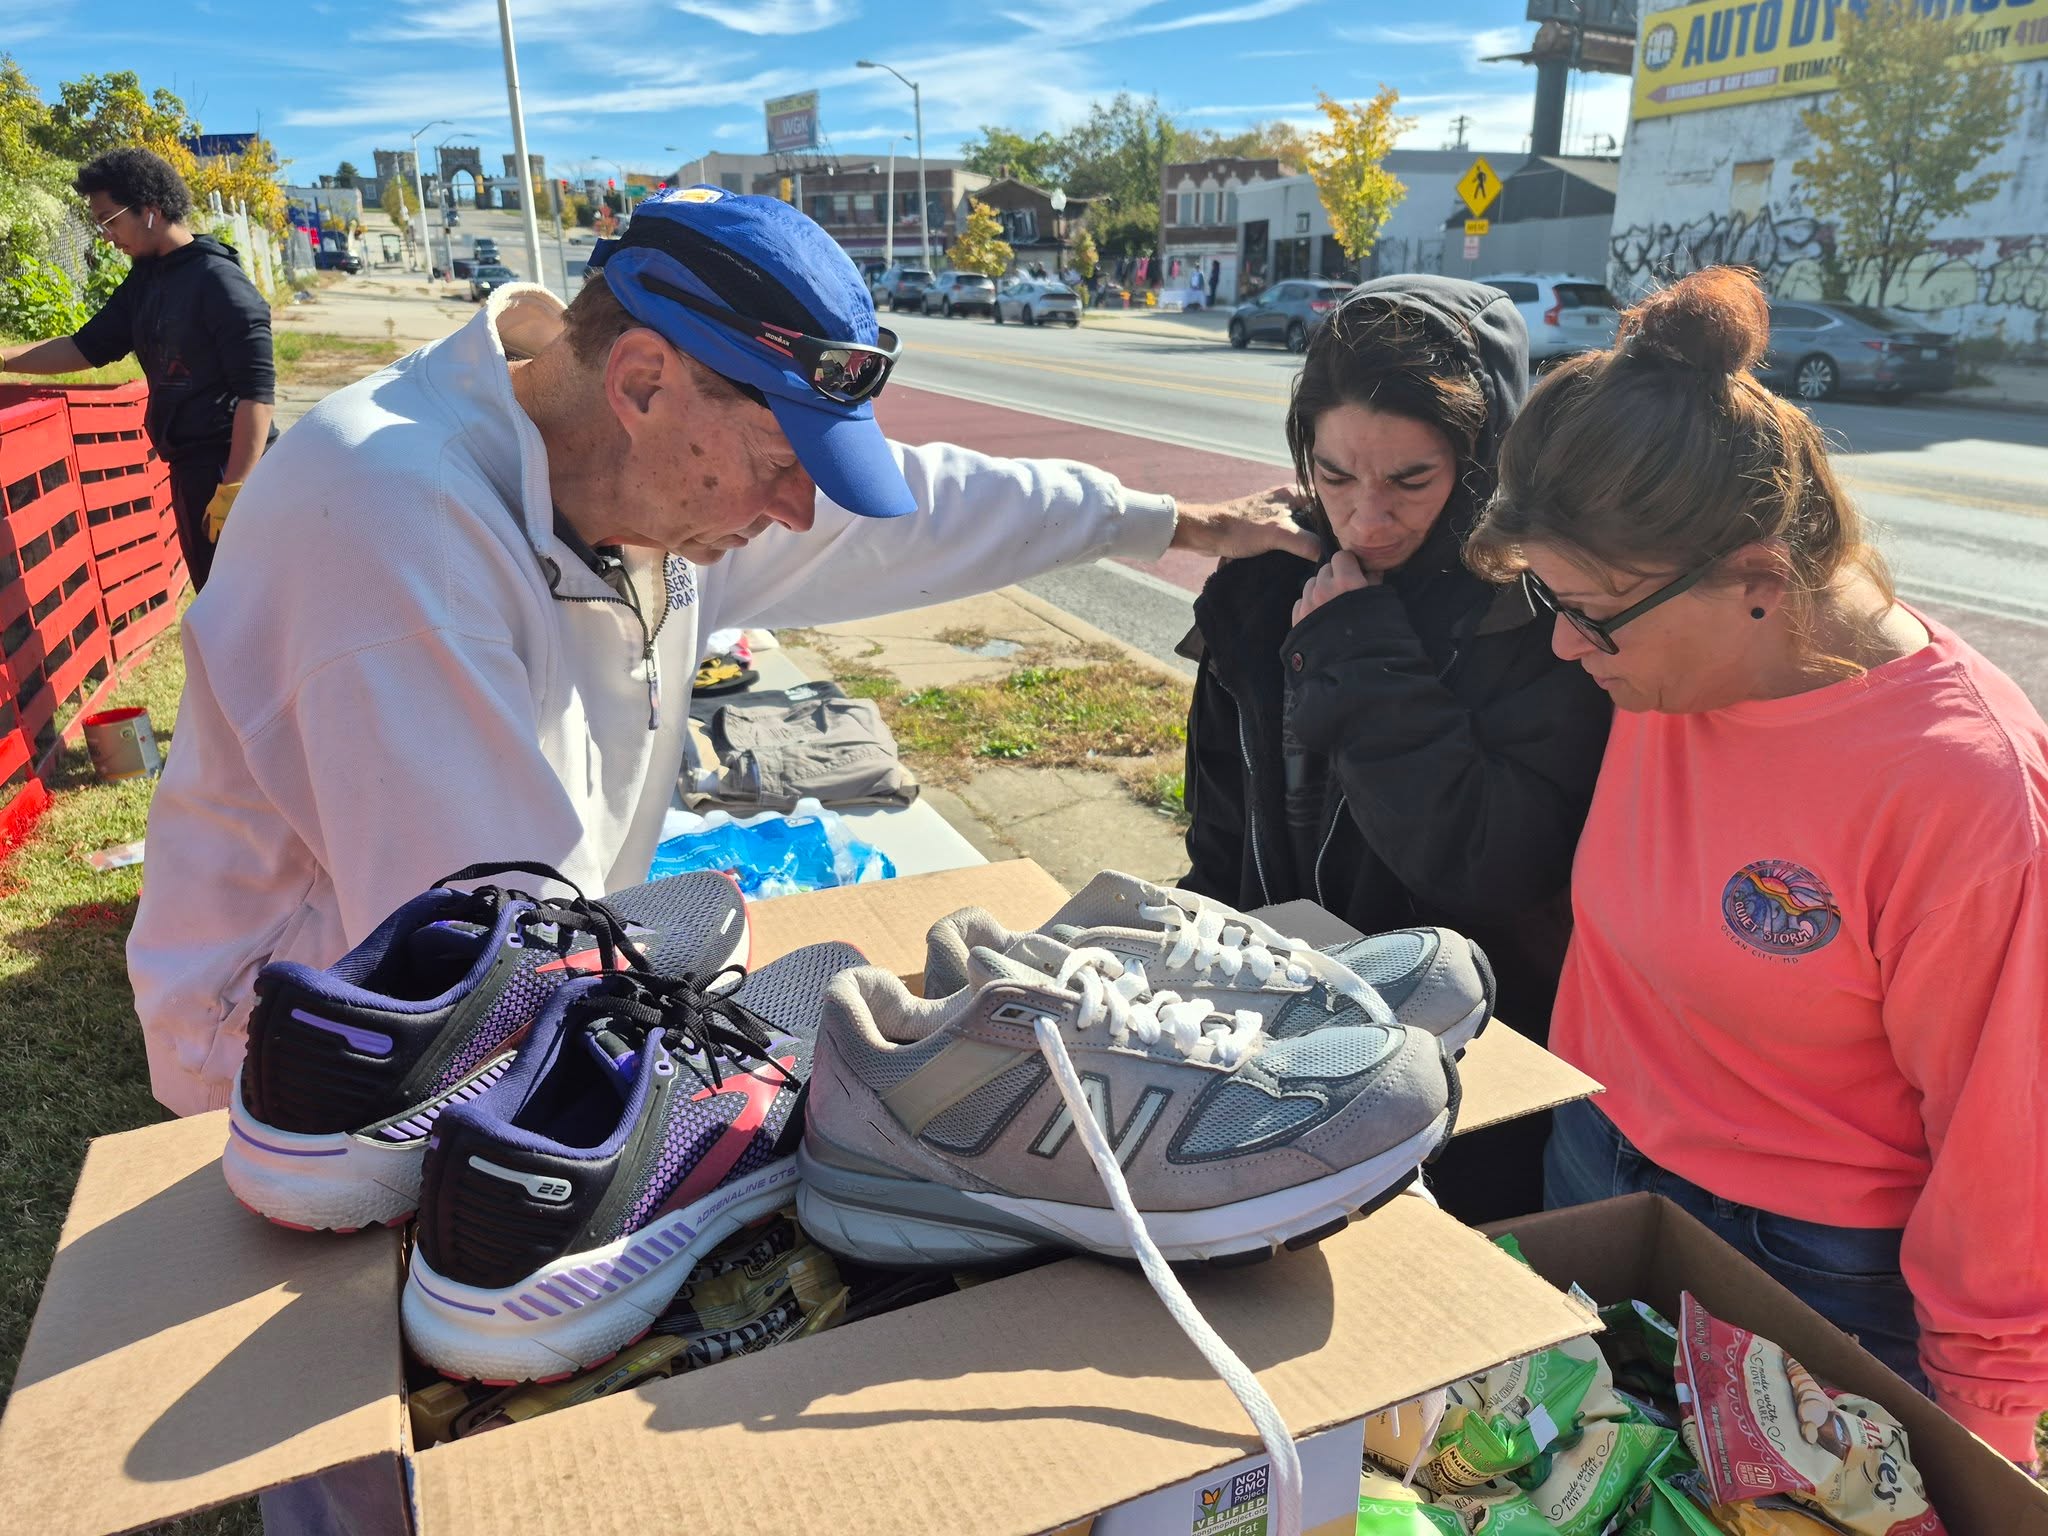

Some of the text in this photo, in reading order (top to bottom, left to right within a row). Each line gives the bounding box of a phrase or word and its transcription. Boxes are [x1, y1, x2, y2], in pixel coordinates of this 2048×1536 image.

[1682, 0, 1783, 68] AUTO
[1734, 901, 1759, 933] QUIET
[1720, 924, 1748, 951] OCEAN
[1783, 957, 1799, 965] MD
[1763, 929, 1811, 945] STORM
[537, 1182, 567, 1197] 22
[696, 1166, 796, 1227] ADRENALINE GTS
[1750, 1366, 1761, 1390] LOVE
[1756, 1398, 1770, 1422] CARE
[1759, 1365, 1777, 1423] made with
[1235, 1478, 1266, 1496] GMO
[1236, 1467, 1266, 1487] NON
[1562, 1456, 1596, 1505] made with
[1566, 1489, 1583, 1511] LOVE
[1584, 1461, 1599, 1482] CARE
[1754, 1467, 1772, 1484] 210
[1234, 1487, 1265, 1504] Project
[1197, 1497, 1265, 1529] VERIFIED
